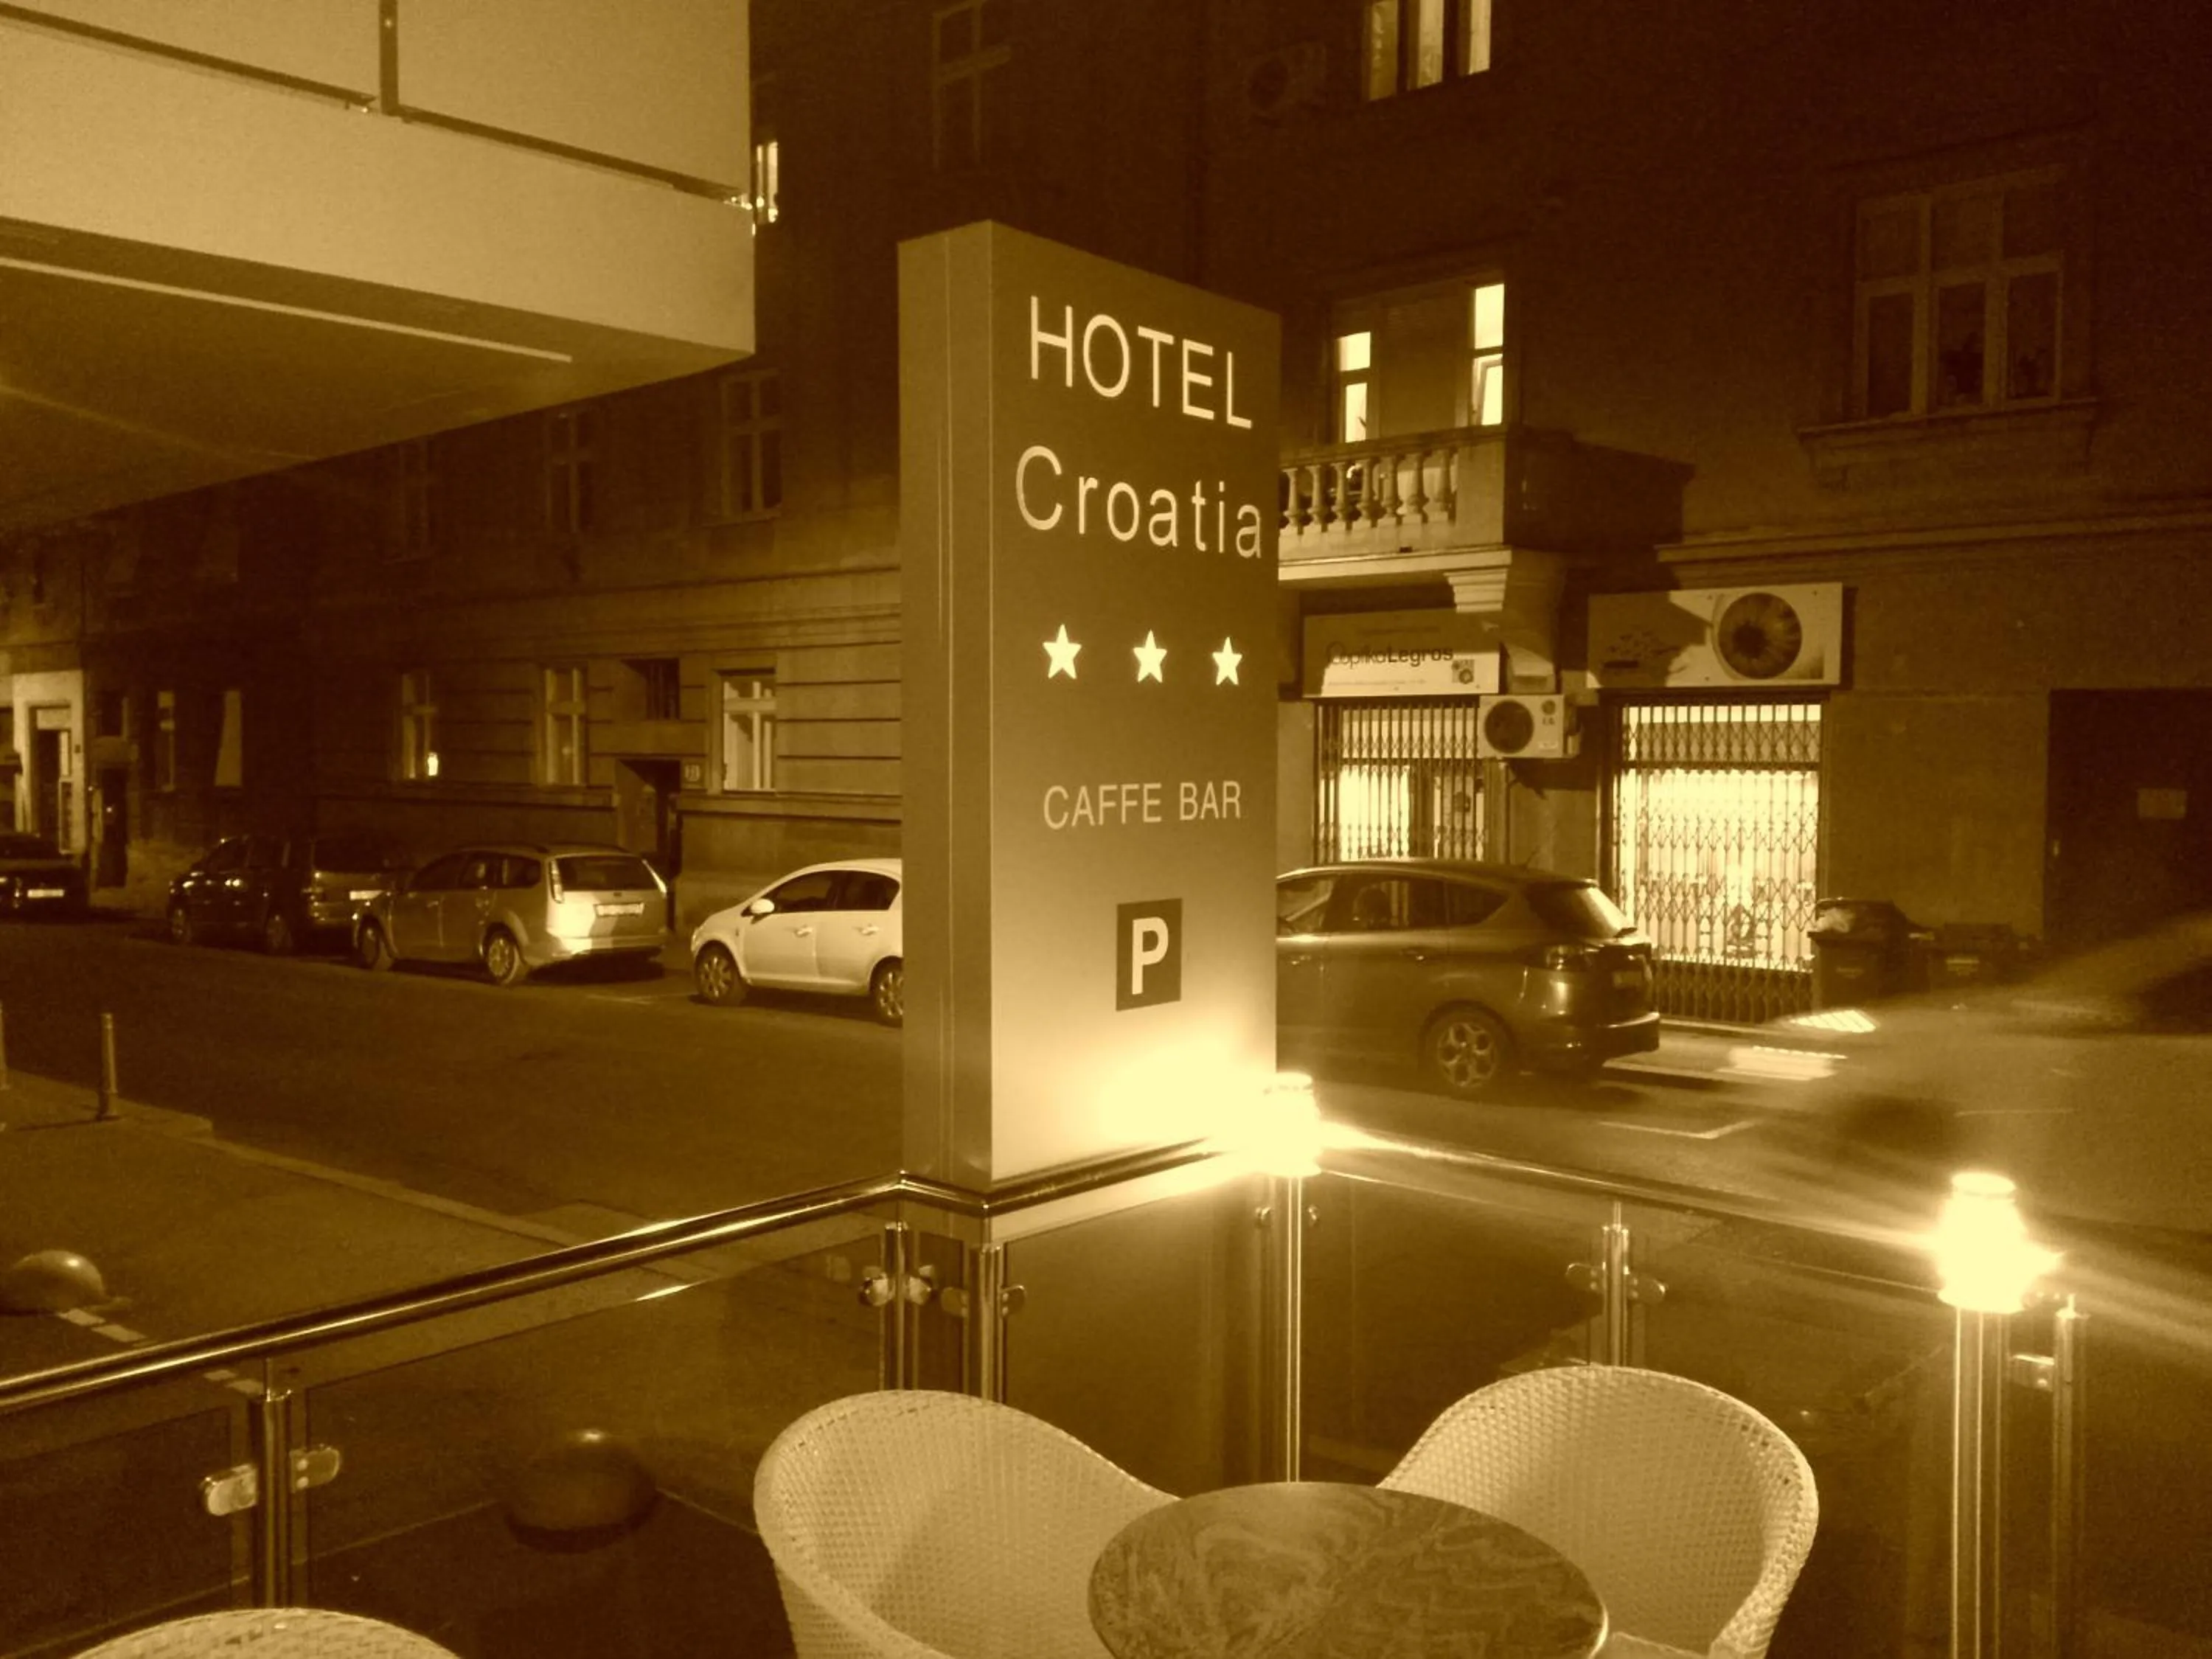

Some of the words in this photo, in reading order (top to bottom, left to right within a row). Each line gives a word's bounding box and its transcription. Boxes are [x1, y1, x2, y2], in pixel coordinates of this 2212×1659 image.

[1031, 296, 1252, 430] HOTEL
[1015, 445, 1262, 559] Croatia
[1043, 782, 1163, 830] CAFFE
[1179, 780, 1242, 821] BAR
[1131, 916, 1169, 995] P
